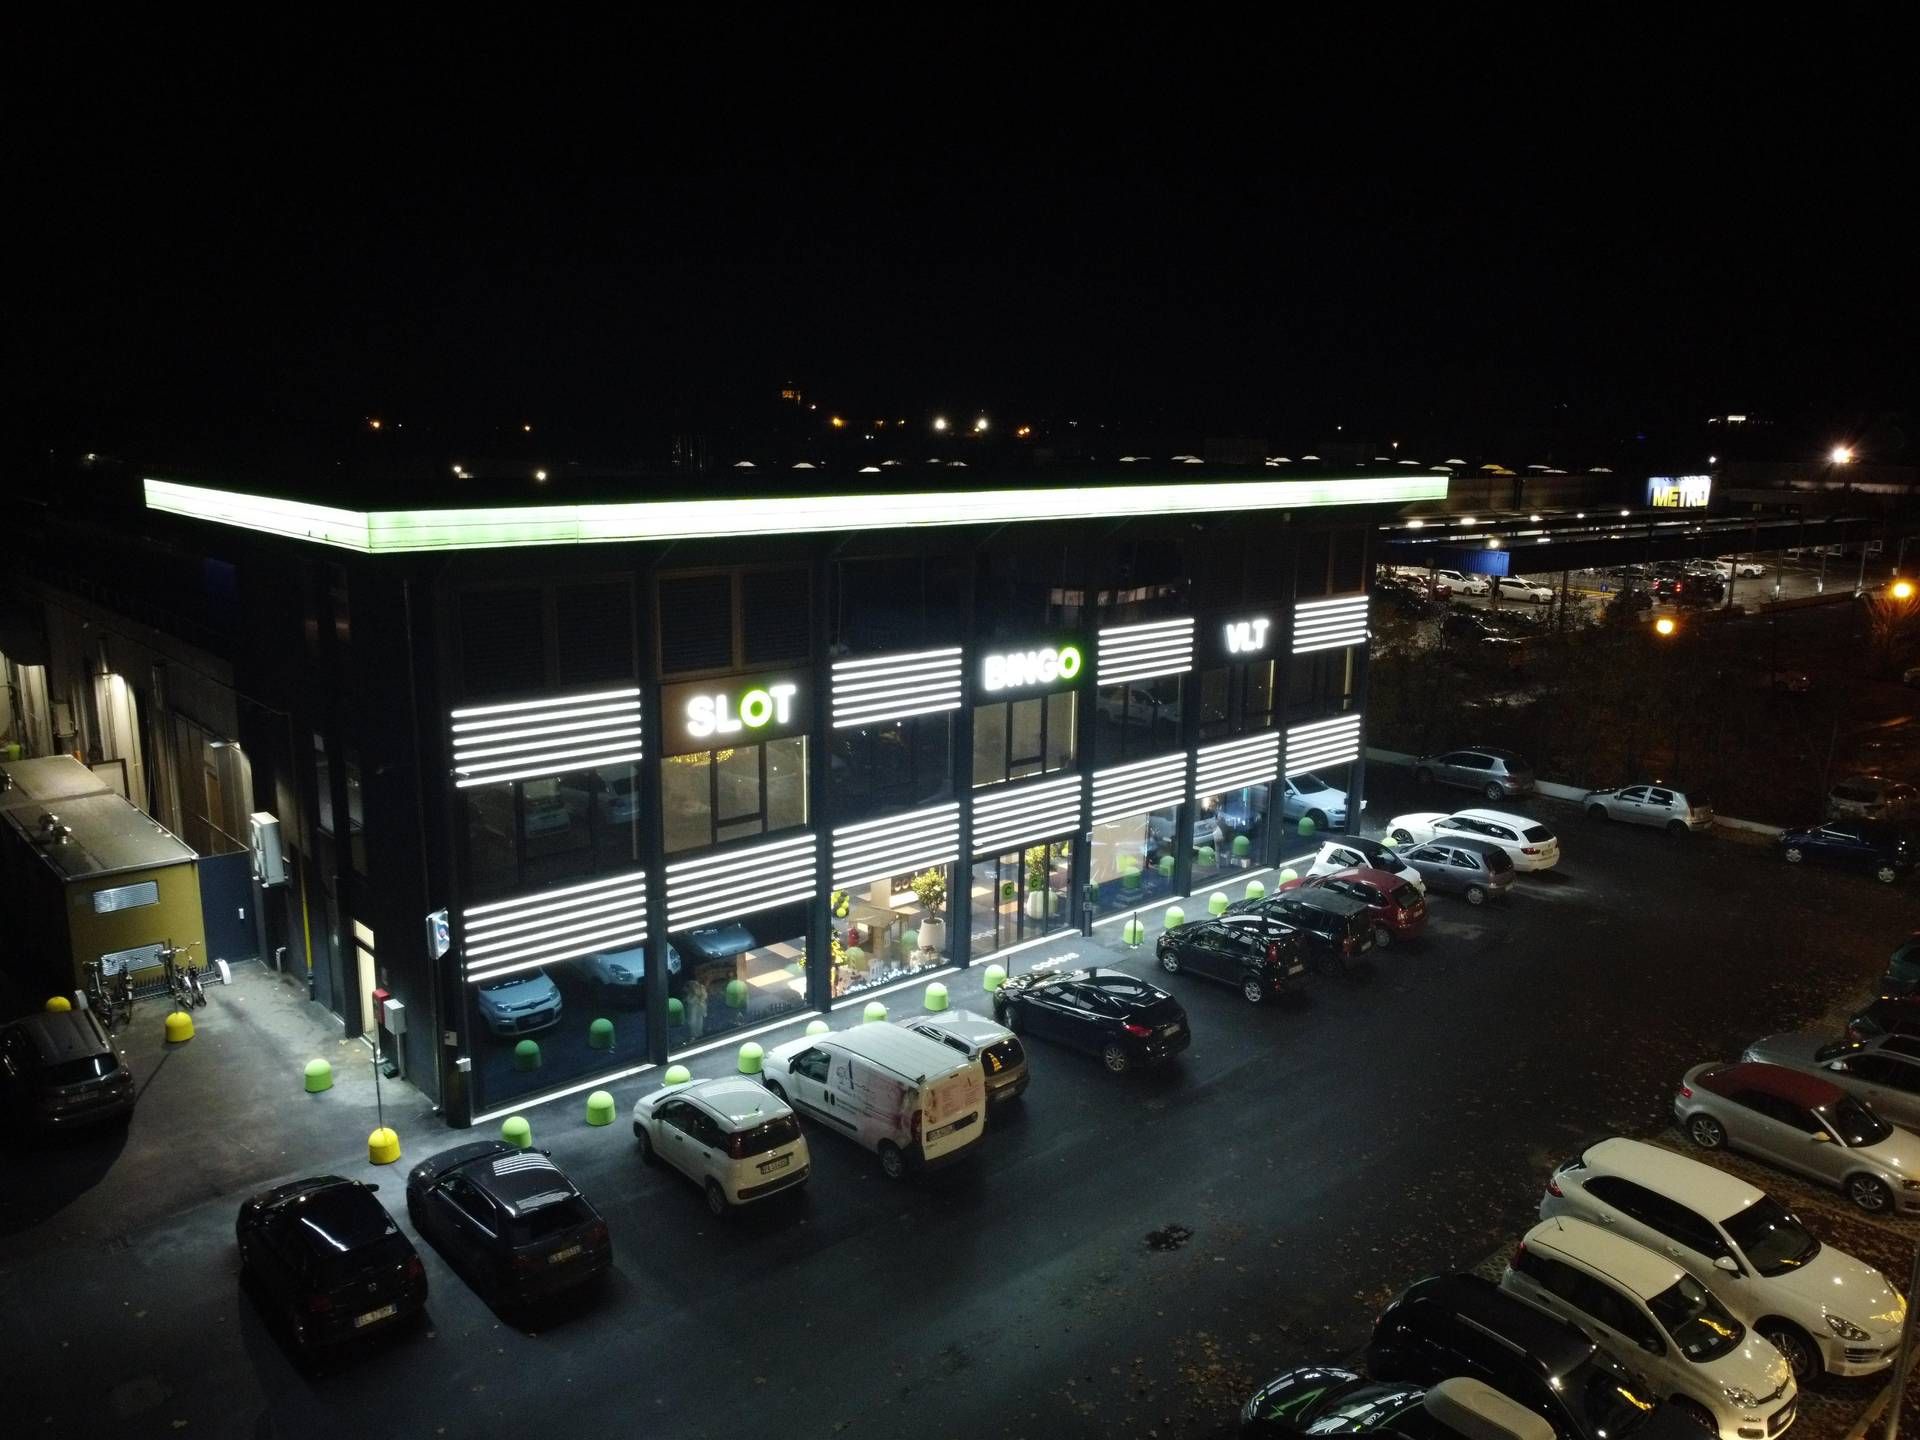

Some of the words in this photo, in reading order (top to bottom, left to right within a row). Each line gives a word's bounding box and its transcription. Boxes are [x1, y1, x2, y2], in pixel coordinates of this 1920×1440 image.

[1651, 486, 1709, 508] METRO
[1225, 618, 1270, 654] VLT
[984, 646, 1082, 692] BINGO
[687, 683, 797, 738] SLOT
